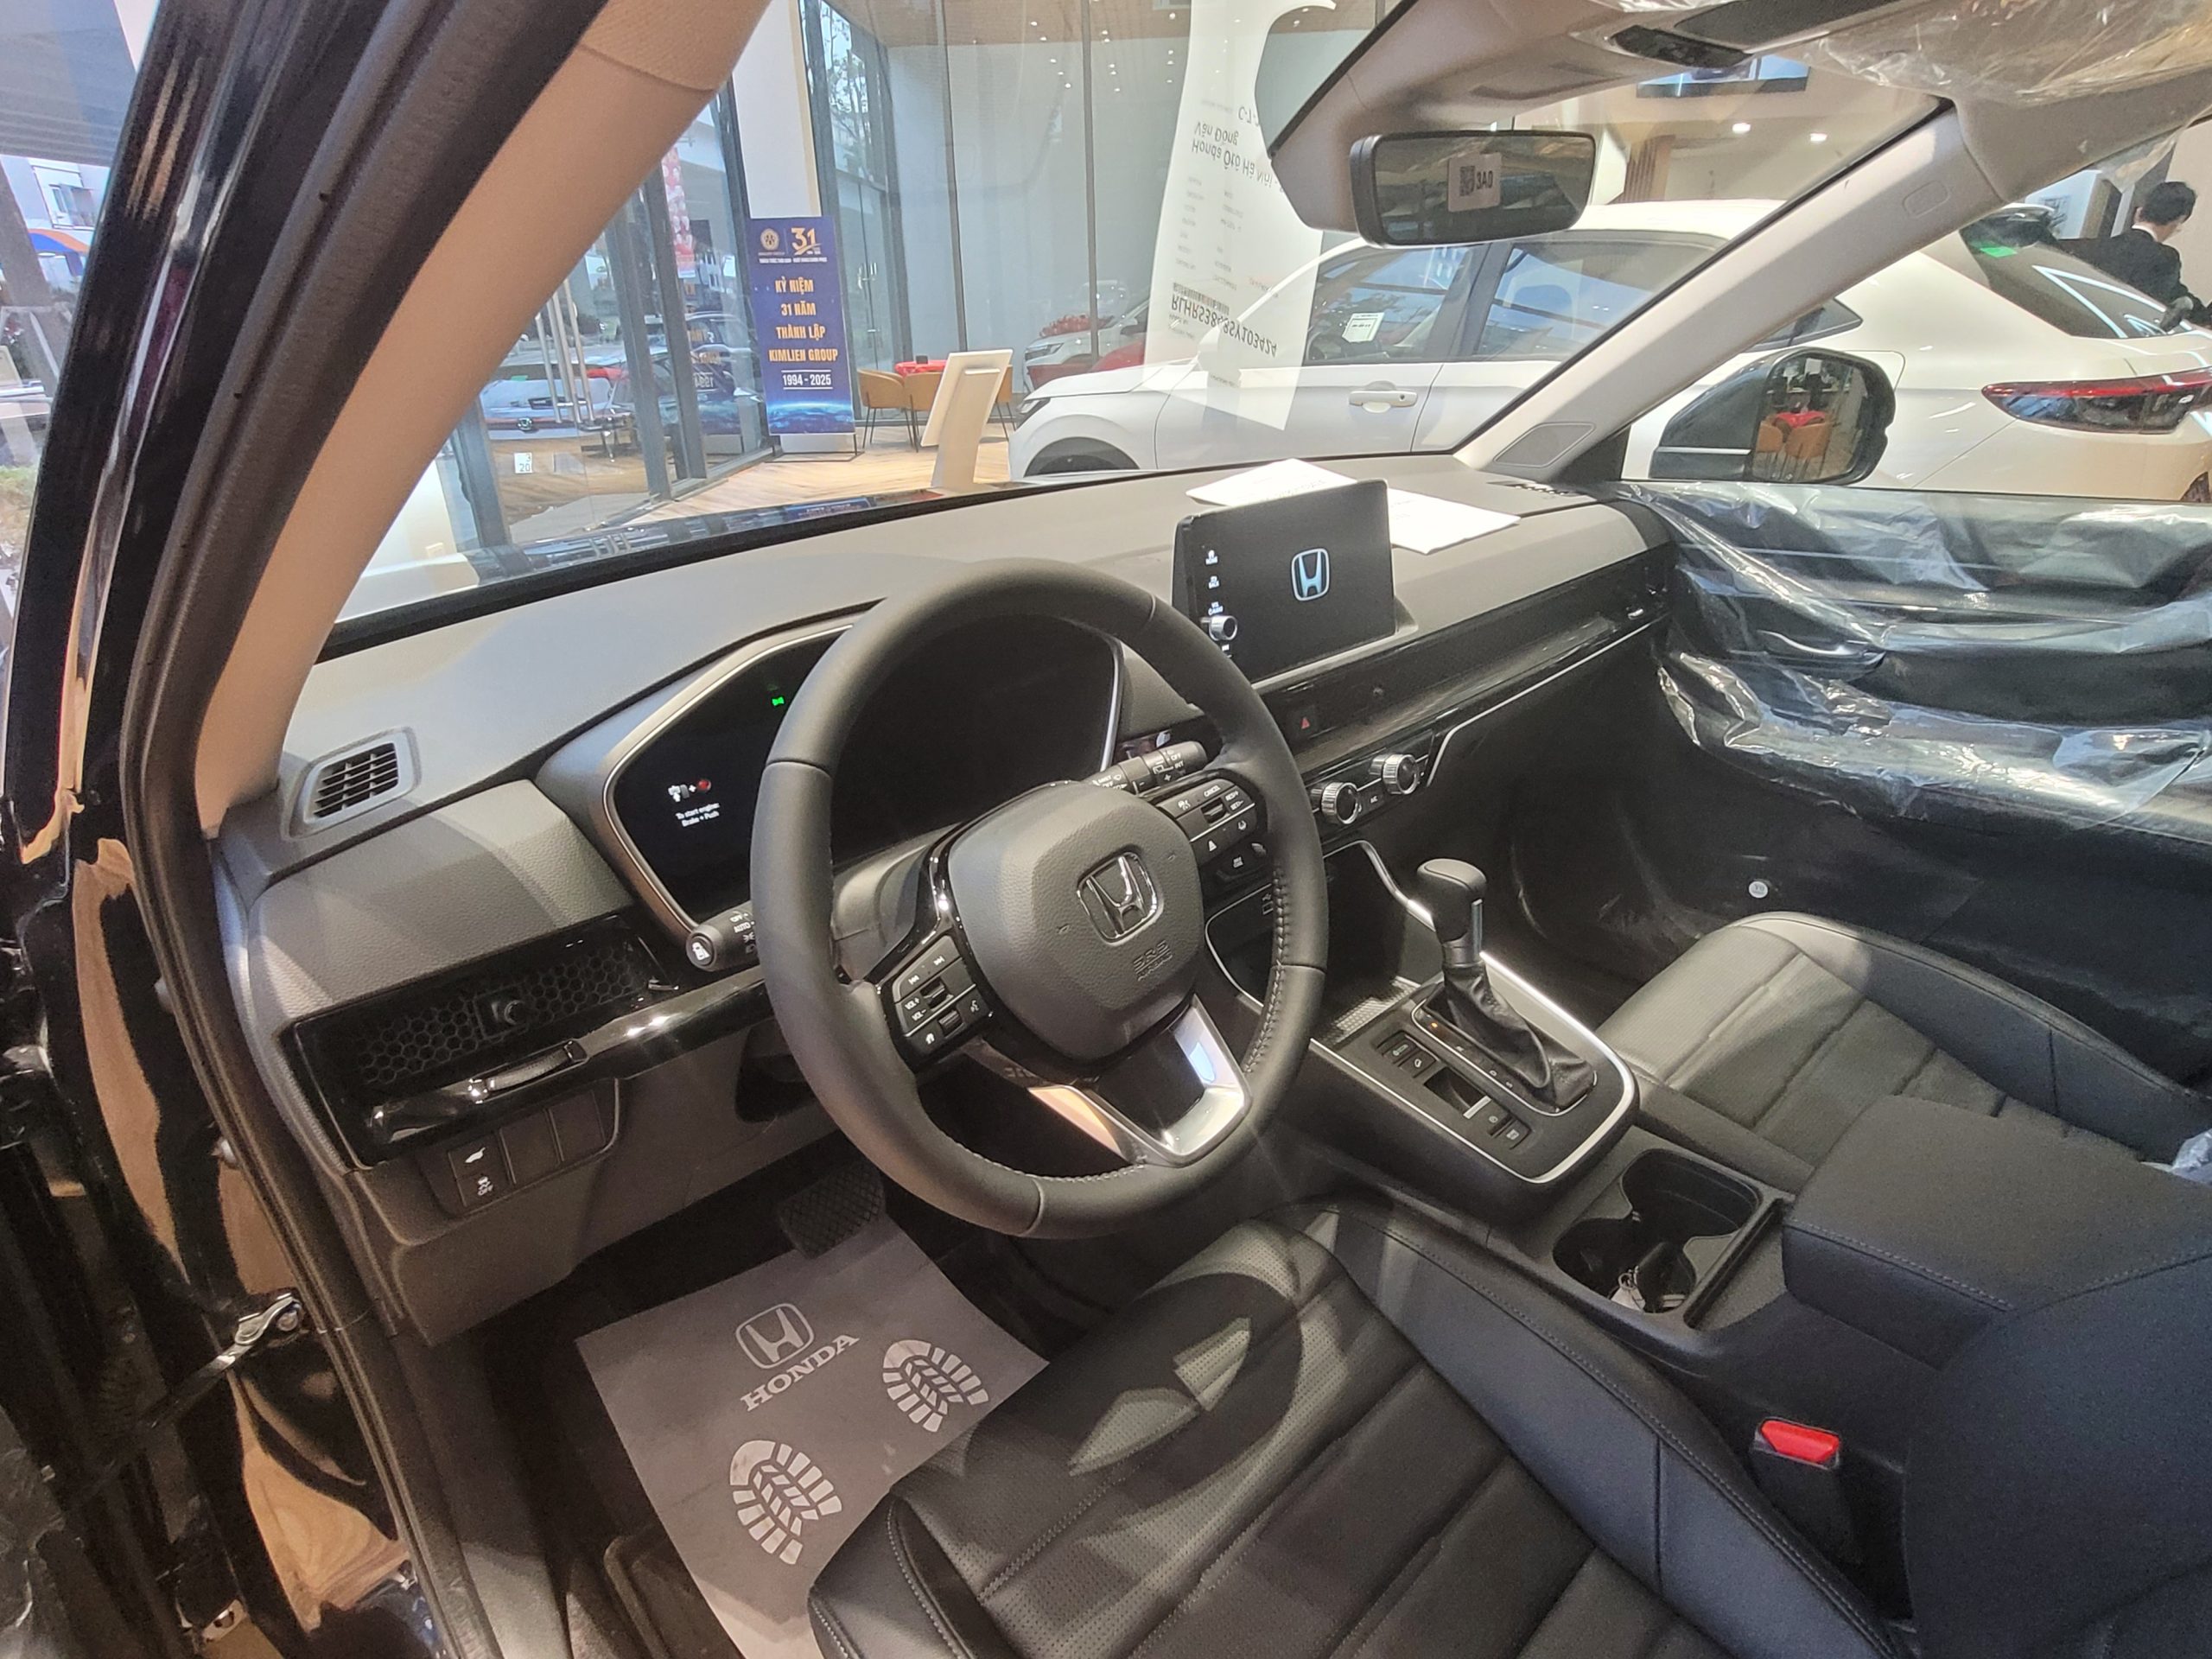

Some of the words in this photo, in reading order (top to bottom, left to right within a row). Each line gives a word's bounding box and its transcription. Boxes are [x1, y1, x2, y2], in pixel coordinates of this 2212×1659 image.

[791, 227, 817, 252] 31
[789, 276, 814, 295] NIỆM
[780, 303, 792, 316] 31
[794, 301, 817, 315] NĂM
[776, 324, 806, 339] THÀNH
[808, 323, 826, 340] LẬP
[768, 349, 806, 361] KIMLIEN
[808, 348, 838, 361] GROUP
[783, 374, 804, 385] 1994
[810, 374, 831, 385] 2025
[1133, 940, 1170, 971] SRS
[739, 1333, 861, 1412] HONDA
